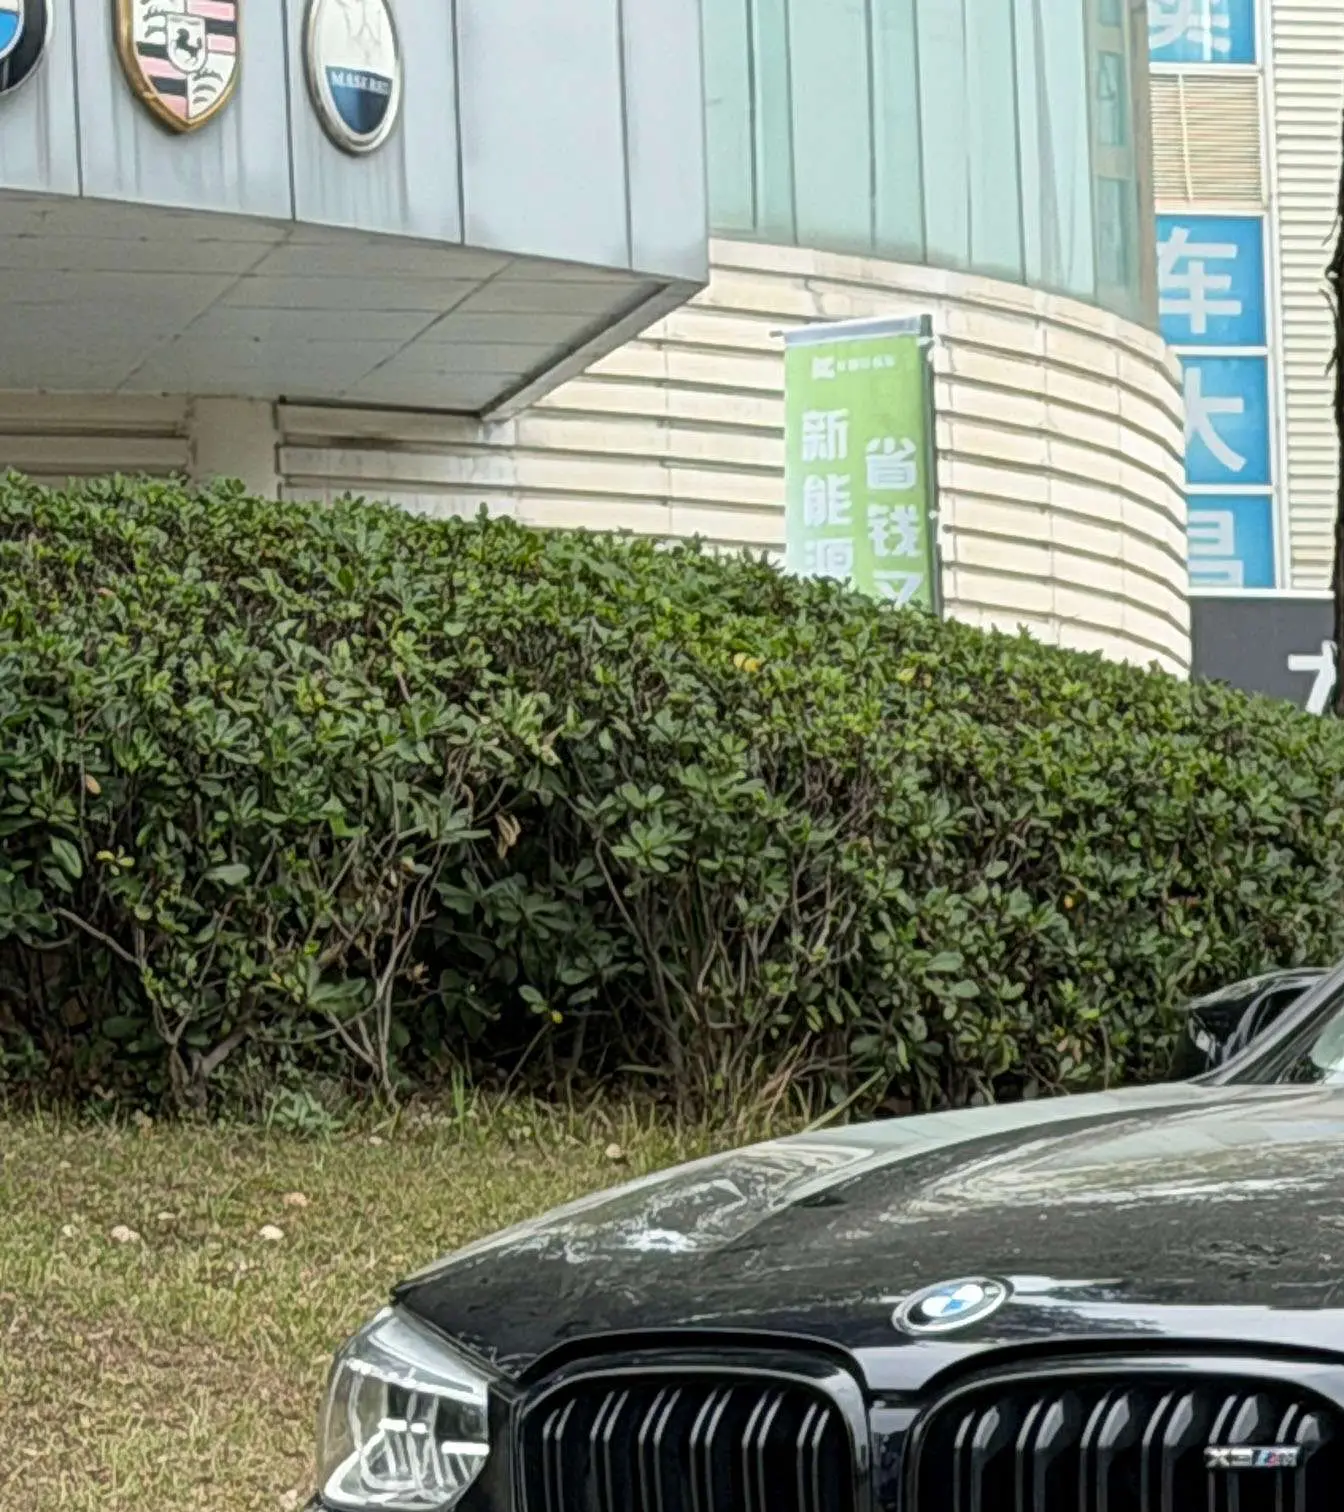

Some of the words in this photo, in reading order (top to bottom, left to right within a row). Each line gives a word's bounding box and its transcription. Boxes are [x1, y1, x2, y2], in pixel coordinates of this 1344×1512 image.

[802, 408, 854, 578] 新能源
[866, 437, 923, 606] 省钱又
